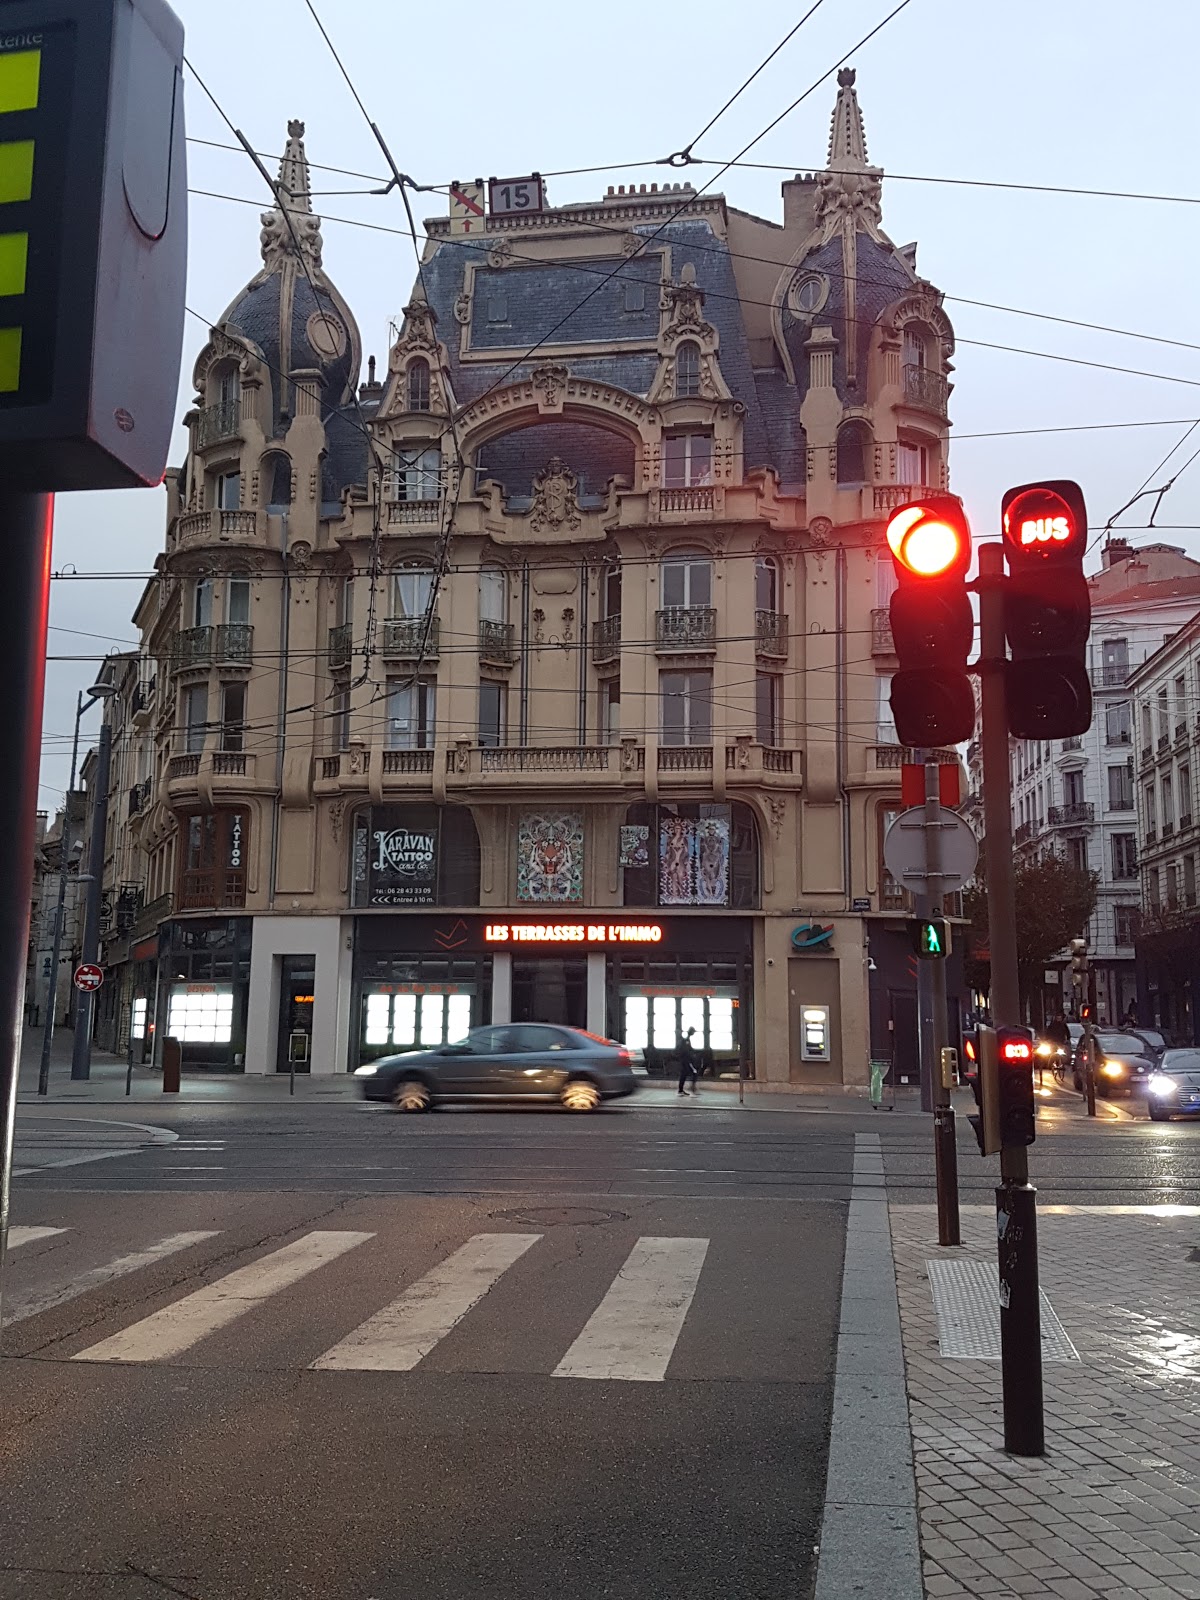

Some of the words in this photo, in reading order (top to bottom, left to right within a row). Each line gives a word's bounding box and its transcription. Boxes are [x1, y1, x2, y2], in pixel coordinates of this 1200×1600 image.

[501, 185, 530, 209] 15
[1021, 516, 1070, 545] BUS
[231, 815, 241, 866] TATTOO
[373, 829, 434, 875] KARAVAN
[391, 852, 432, 861] TATTOO
[399, 861, 416, 869] and
[486, 926, 508, 941] LES
[511, 925, 585, 941] TERRASSES
[587, 925, 606, 941] DE
[608, 925, 662, 941] L'IMMO
